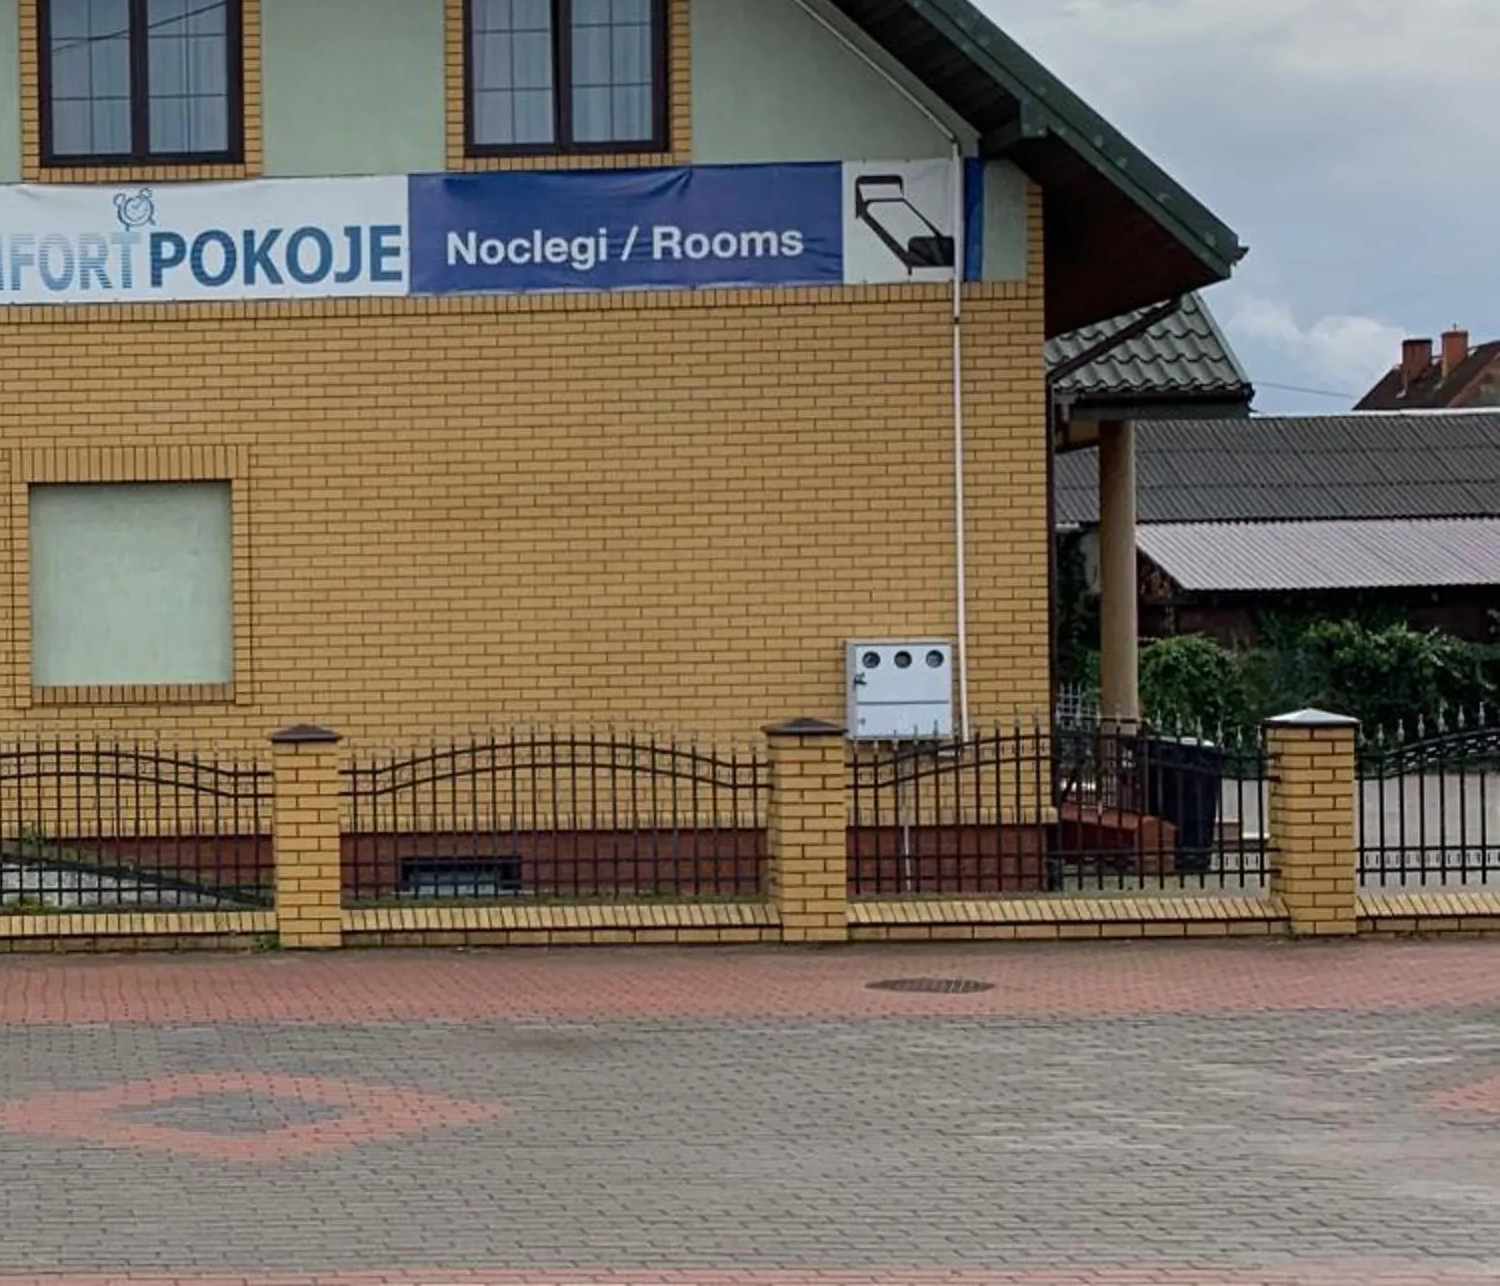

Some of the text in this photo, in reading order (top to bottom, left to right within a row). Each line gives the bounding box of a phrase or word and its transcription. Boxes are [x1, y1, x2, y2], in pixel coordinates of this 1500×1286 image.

[150, 225, 403, 288] POKOJE
[446, 227, 608, 270] Noclegi
[651, 225, 804, 260] Rooms
